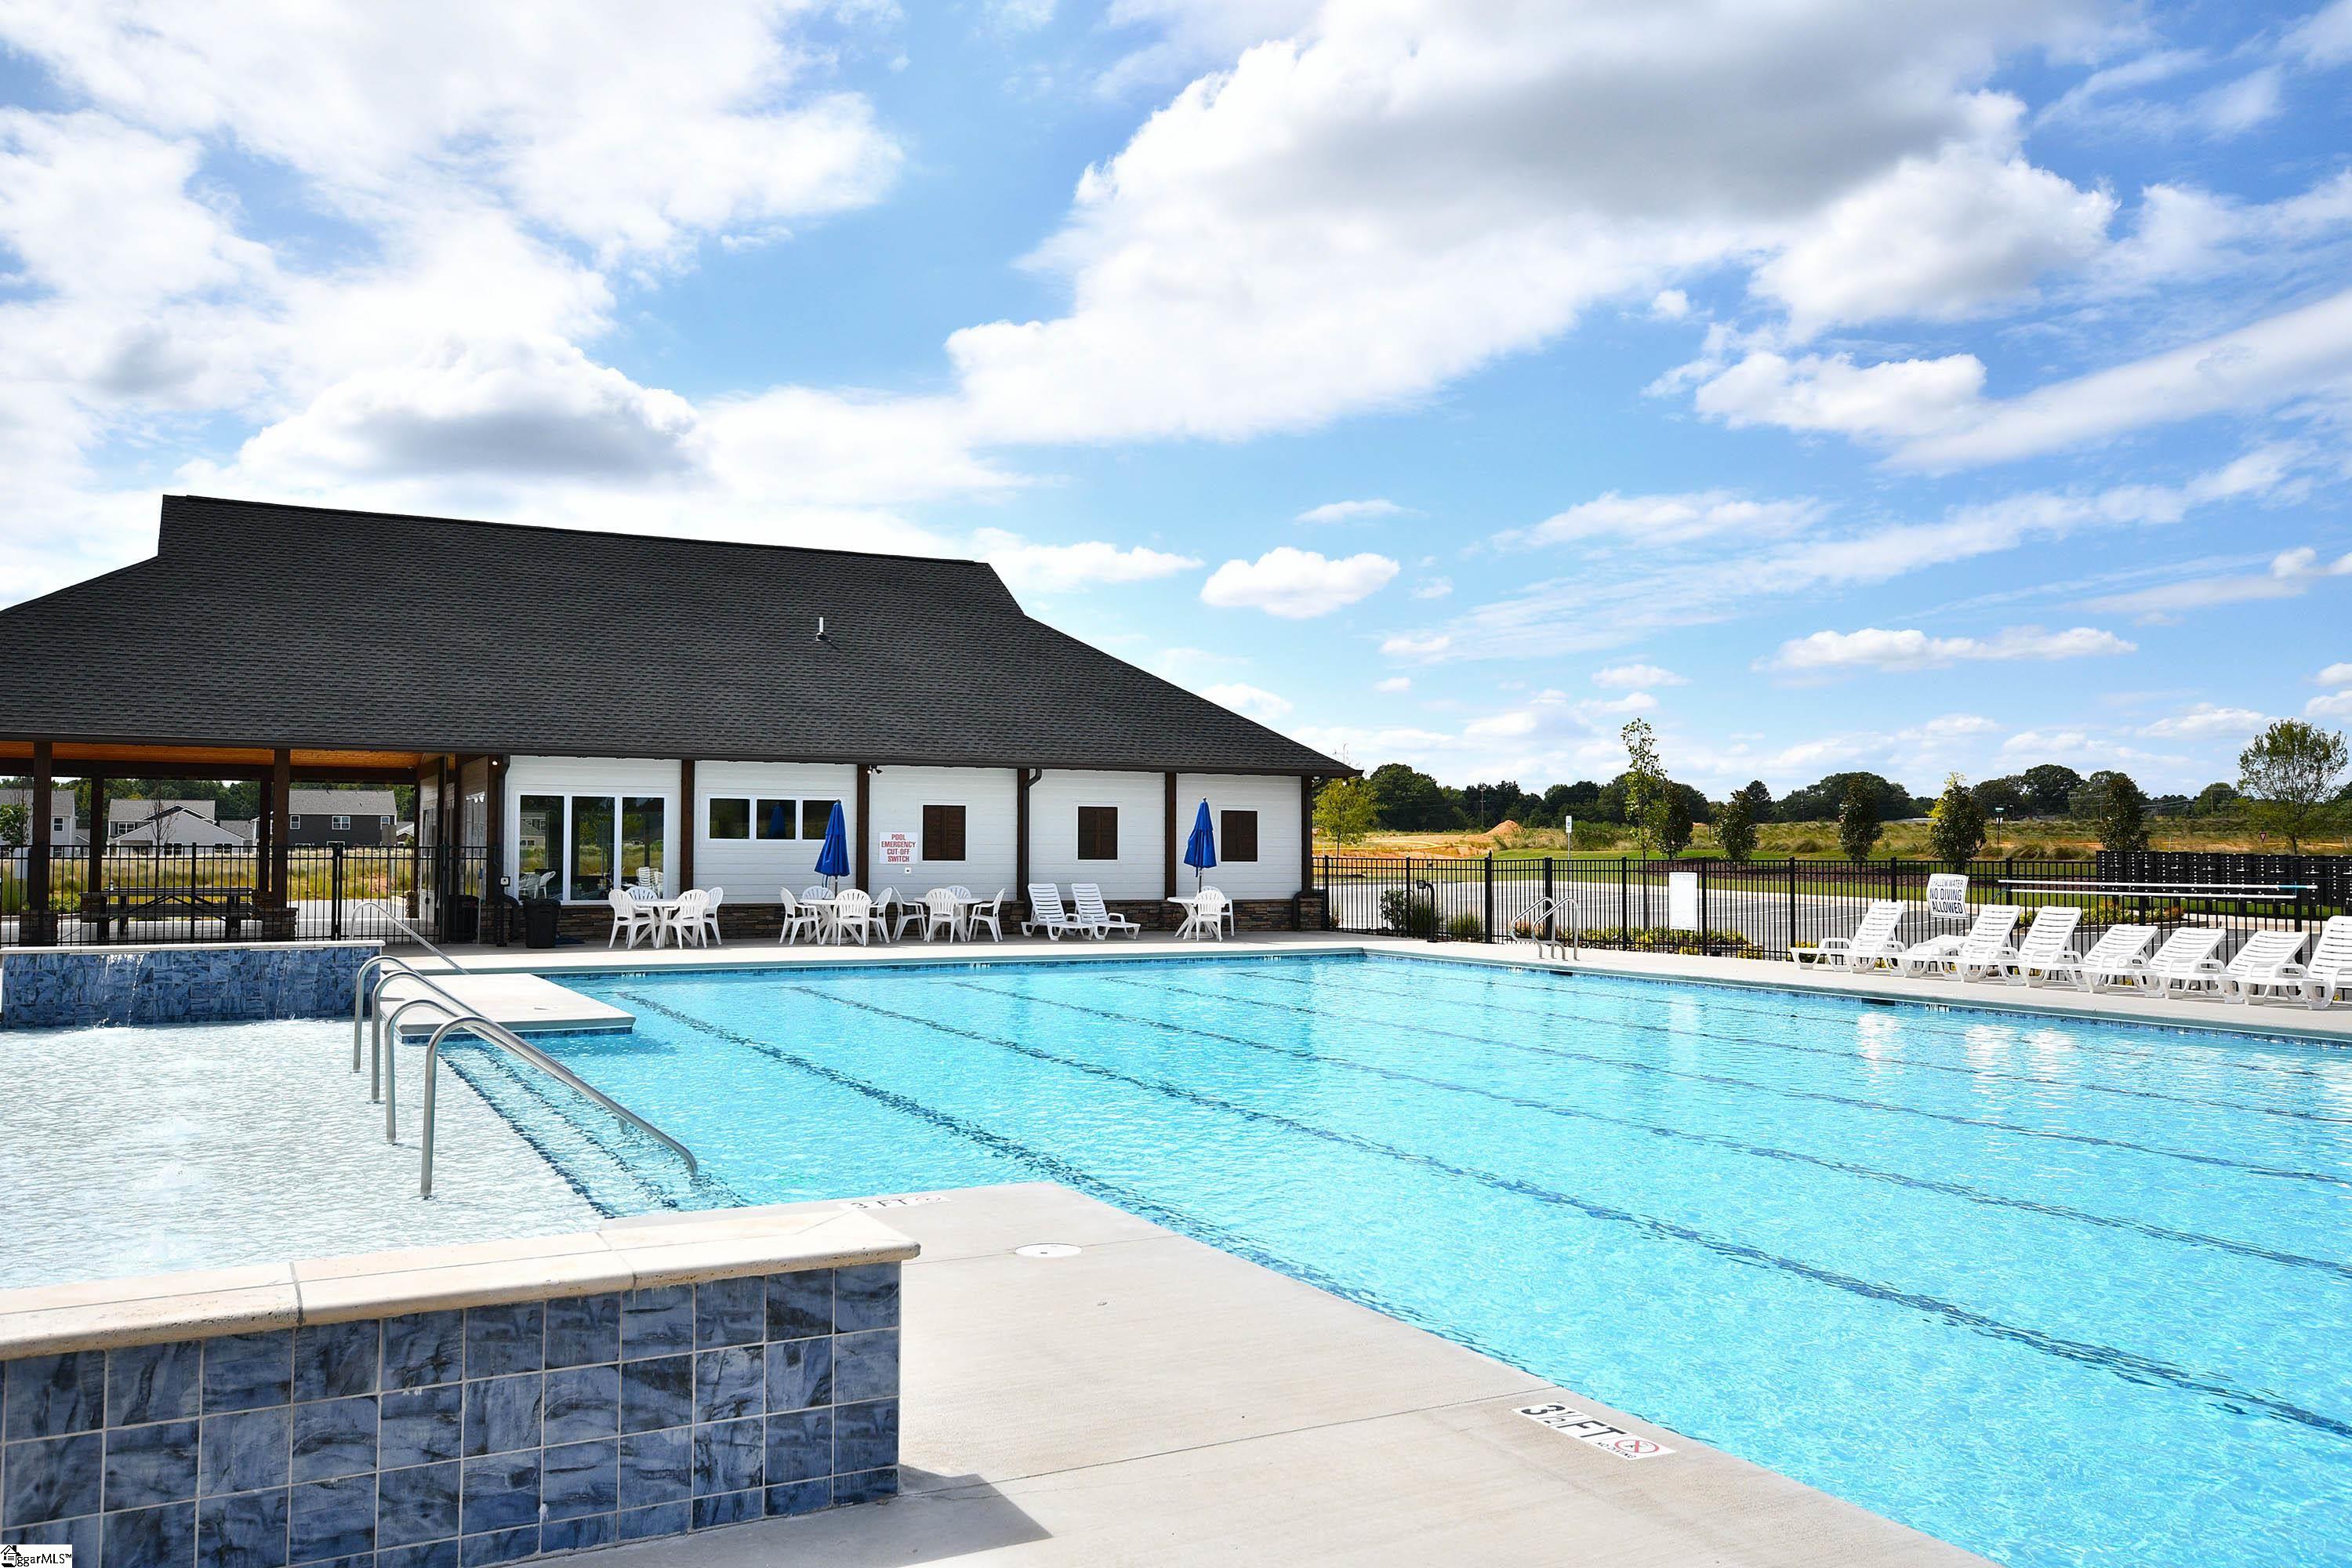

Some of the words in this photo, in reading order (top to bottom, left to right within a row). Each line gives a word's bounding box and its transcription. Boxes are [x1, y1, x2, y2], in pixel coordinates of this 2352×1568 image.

[1929, 887, 1939, 900] NO
[1940, 888, 1962, 902] DIVING
[1932, 901, 1963, 914] ALLOWED
[1556, 1420, 1628, 1438] FT
